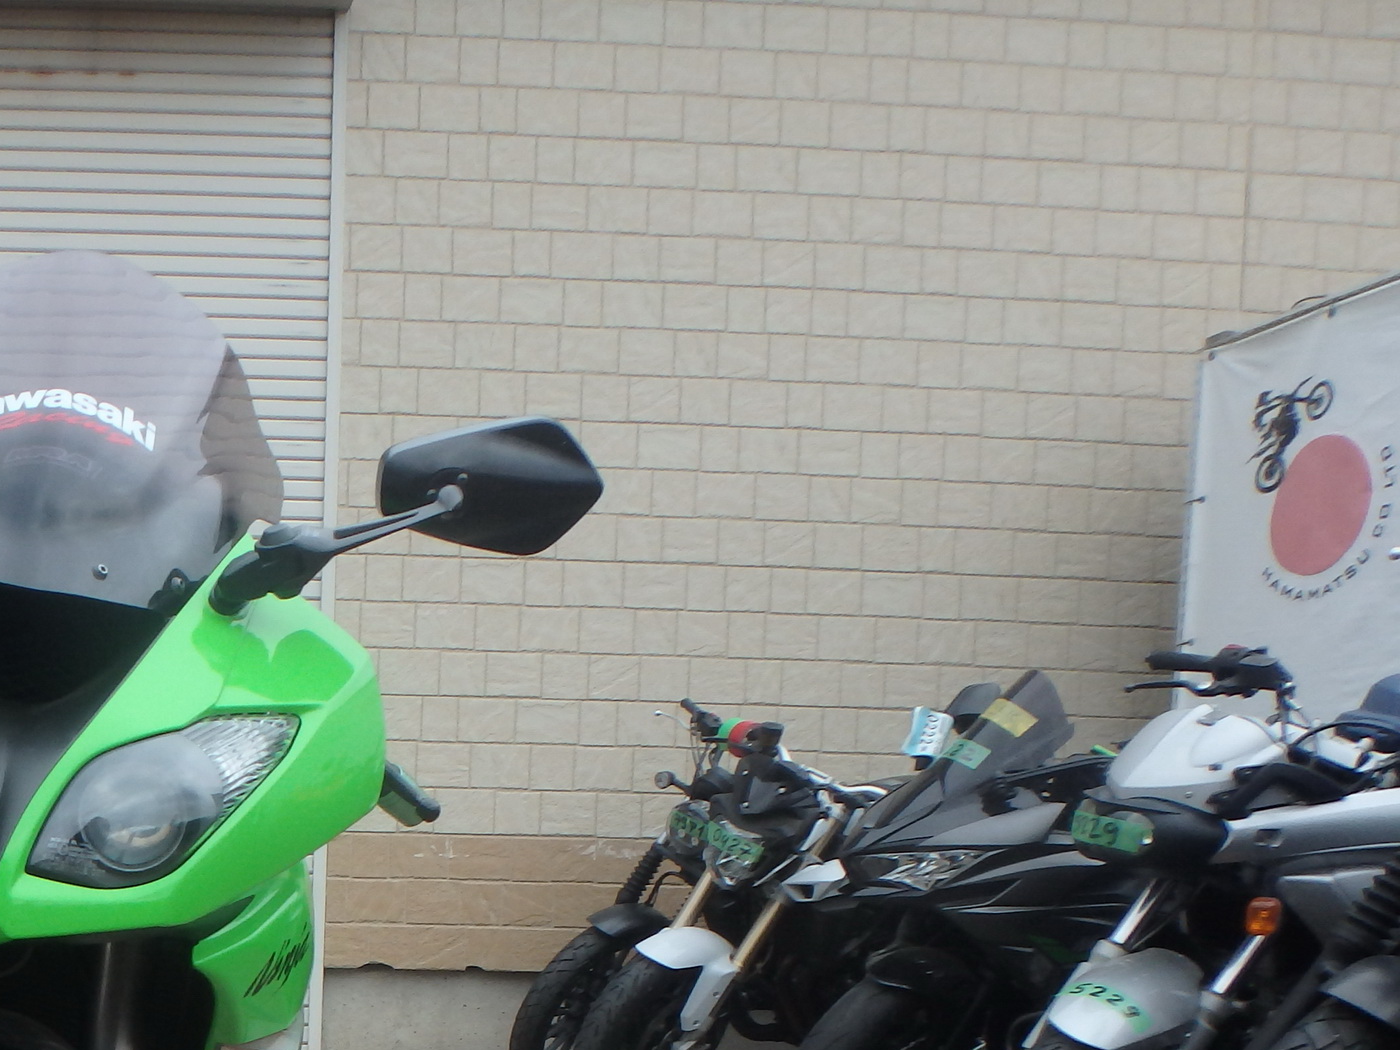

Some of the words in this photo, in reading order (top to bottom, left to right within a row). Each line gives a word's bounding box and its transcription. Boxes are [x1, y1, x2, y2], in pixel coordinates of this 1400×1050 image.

[1261, 549, 1371, 601] HAMAMATSU
[243, 922, 311, 998] Ninja
[1068, 983, 1141, 1019] 5229
